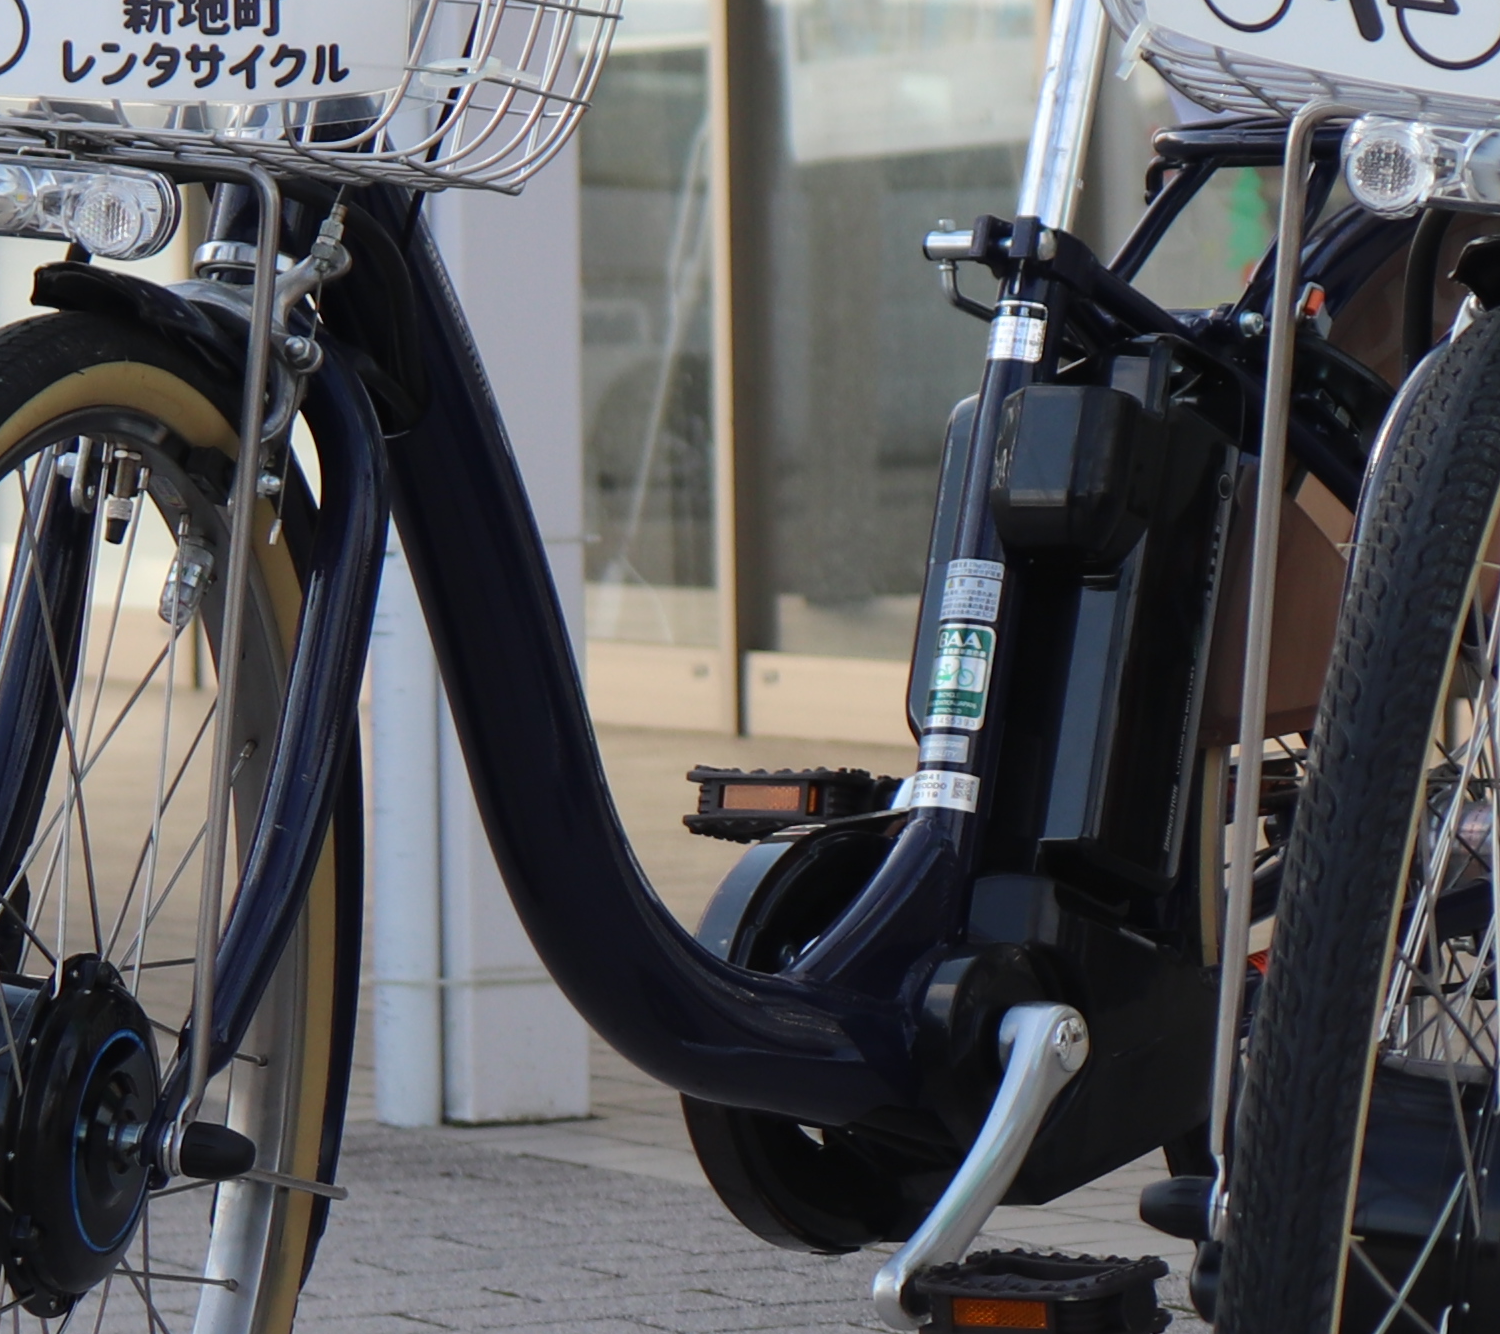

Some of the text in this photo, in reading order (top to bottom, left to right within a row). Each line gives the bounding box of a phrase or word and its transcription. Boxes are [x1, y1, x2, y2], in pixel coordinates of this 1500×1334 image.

[62, 40, 349, 90] レンタサイクル
[938, 630, 982, 650] BAA
